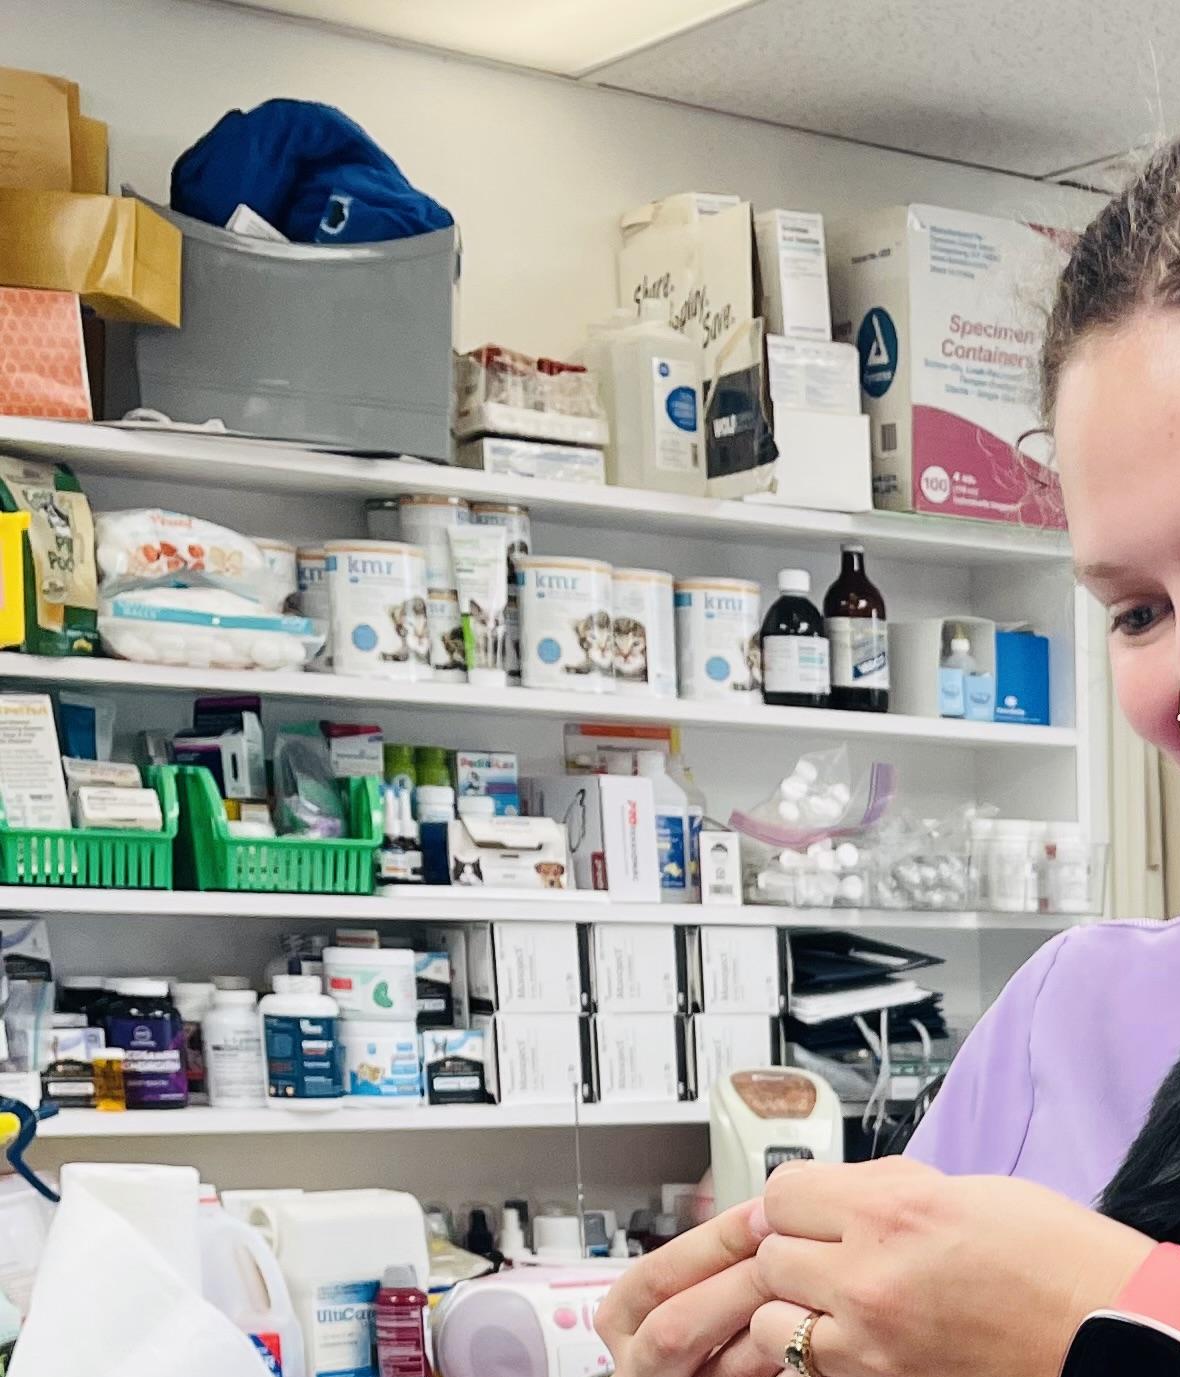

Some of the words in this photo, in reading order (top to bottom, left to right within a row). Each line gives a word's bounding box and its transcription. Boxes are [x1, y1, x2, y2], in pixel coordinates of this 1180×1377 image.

[949, 313, 1035, 347] Specimen
[347, 555, 393, 575] kmr
[535, 570, 580, 591] kmr
[703, 592, 743, 612] kmr
